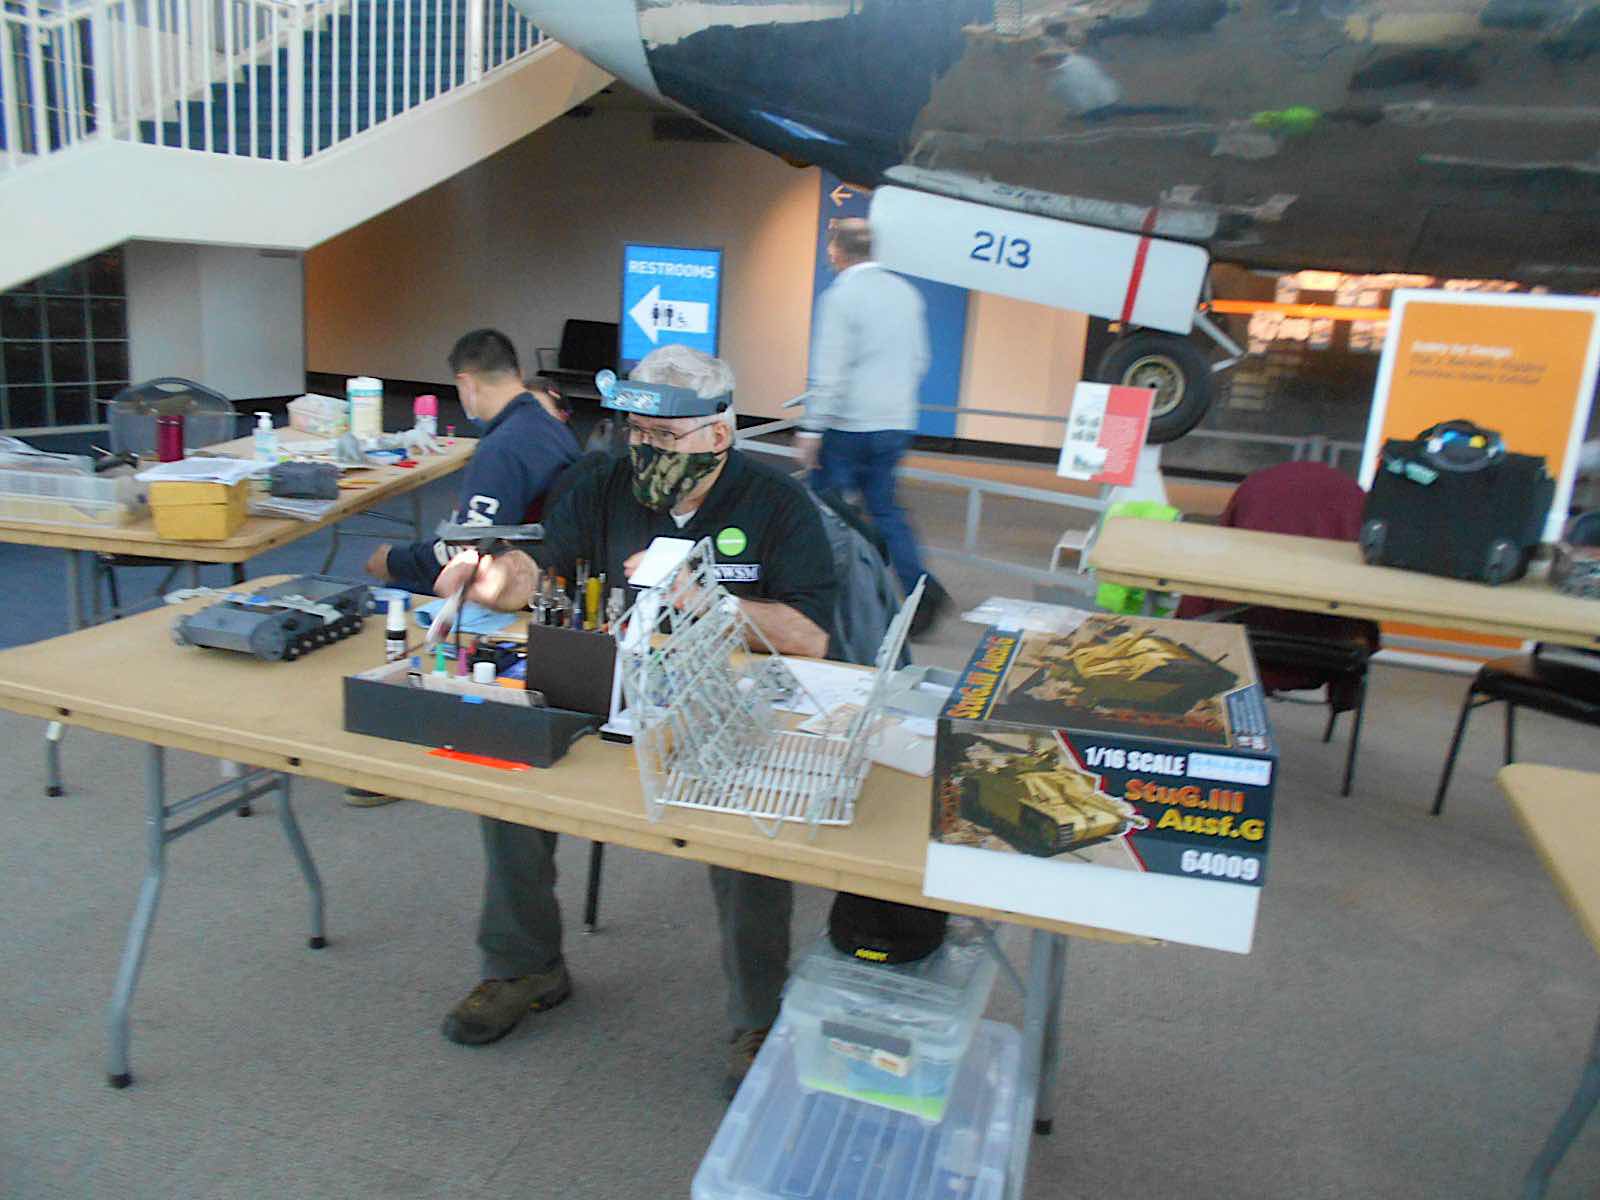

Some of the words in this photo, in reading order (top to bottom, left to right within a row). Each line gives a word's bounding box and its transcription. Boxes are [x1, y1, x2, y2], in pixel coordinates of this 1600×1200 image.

[970, 231, 1031, 269] 213
[629, 260, 716, 279] RESTROOMS
[1126, 750, 1186, 776] SCALE
[1180, 849, 1261, 881] 64009
